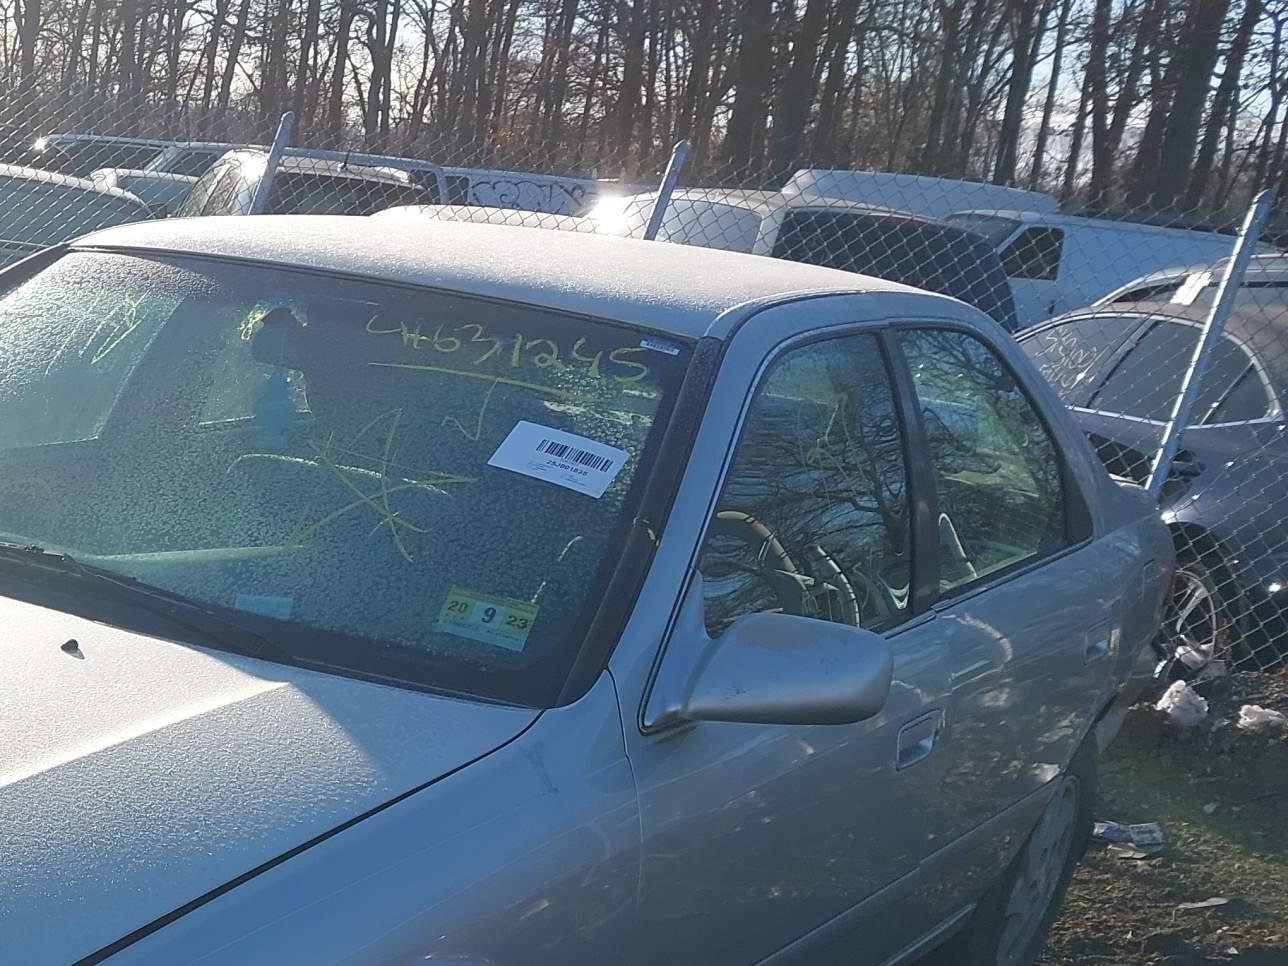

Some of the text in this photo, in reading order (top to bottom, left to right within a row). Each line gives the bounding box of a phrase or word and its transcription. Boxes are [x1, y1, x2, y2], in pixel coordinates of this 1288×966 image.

[447, 600, 529, 630] 20 9 23
